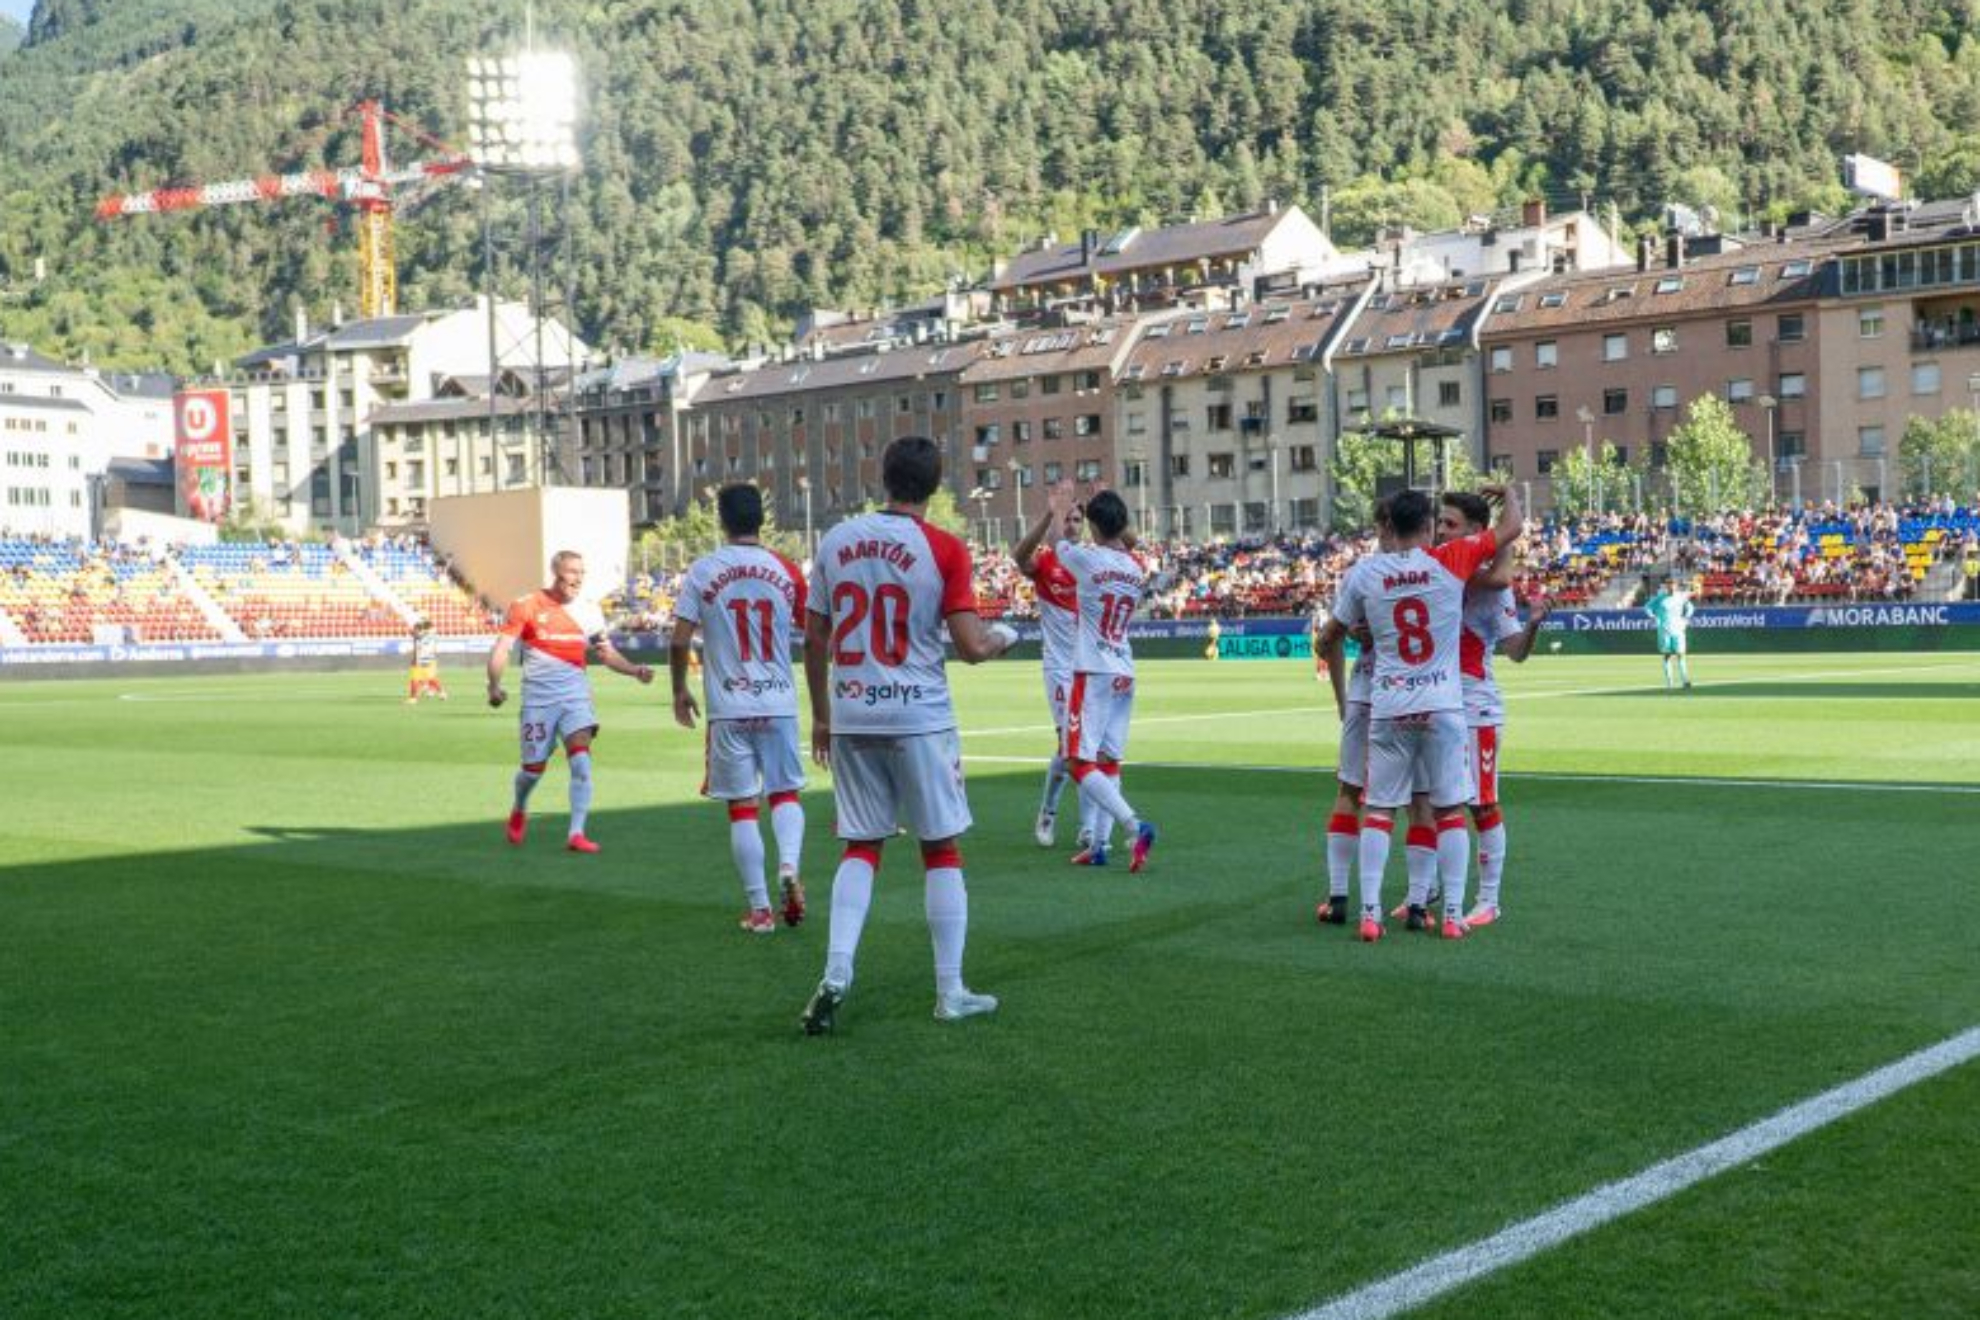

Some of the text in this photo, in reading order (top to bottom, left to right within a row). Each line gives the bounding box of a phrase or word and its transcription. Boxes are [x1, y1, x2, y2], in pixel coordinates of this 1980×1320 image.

[187, 409, 206, 429] U
[838, 540, 917, 573] MARTÓN
[1383, 571, 1430, 592] MADA
[727, 598, 775, 662] 11
[832, 581, 910, 668] 20
[1099, 593, 1135, 642] 10
[1826, 606, 1949, 626] MORABANC
[1393, 596, 1435, 667] 8
[865, 681, 922, 705] galys
[524, 723, 547, 742] 23
